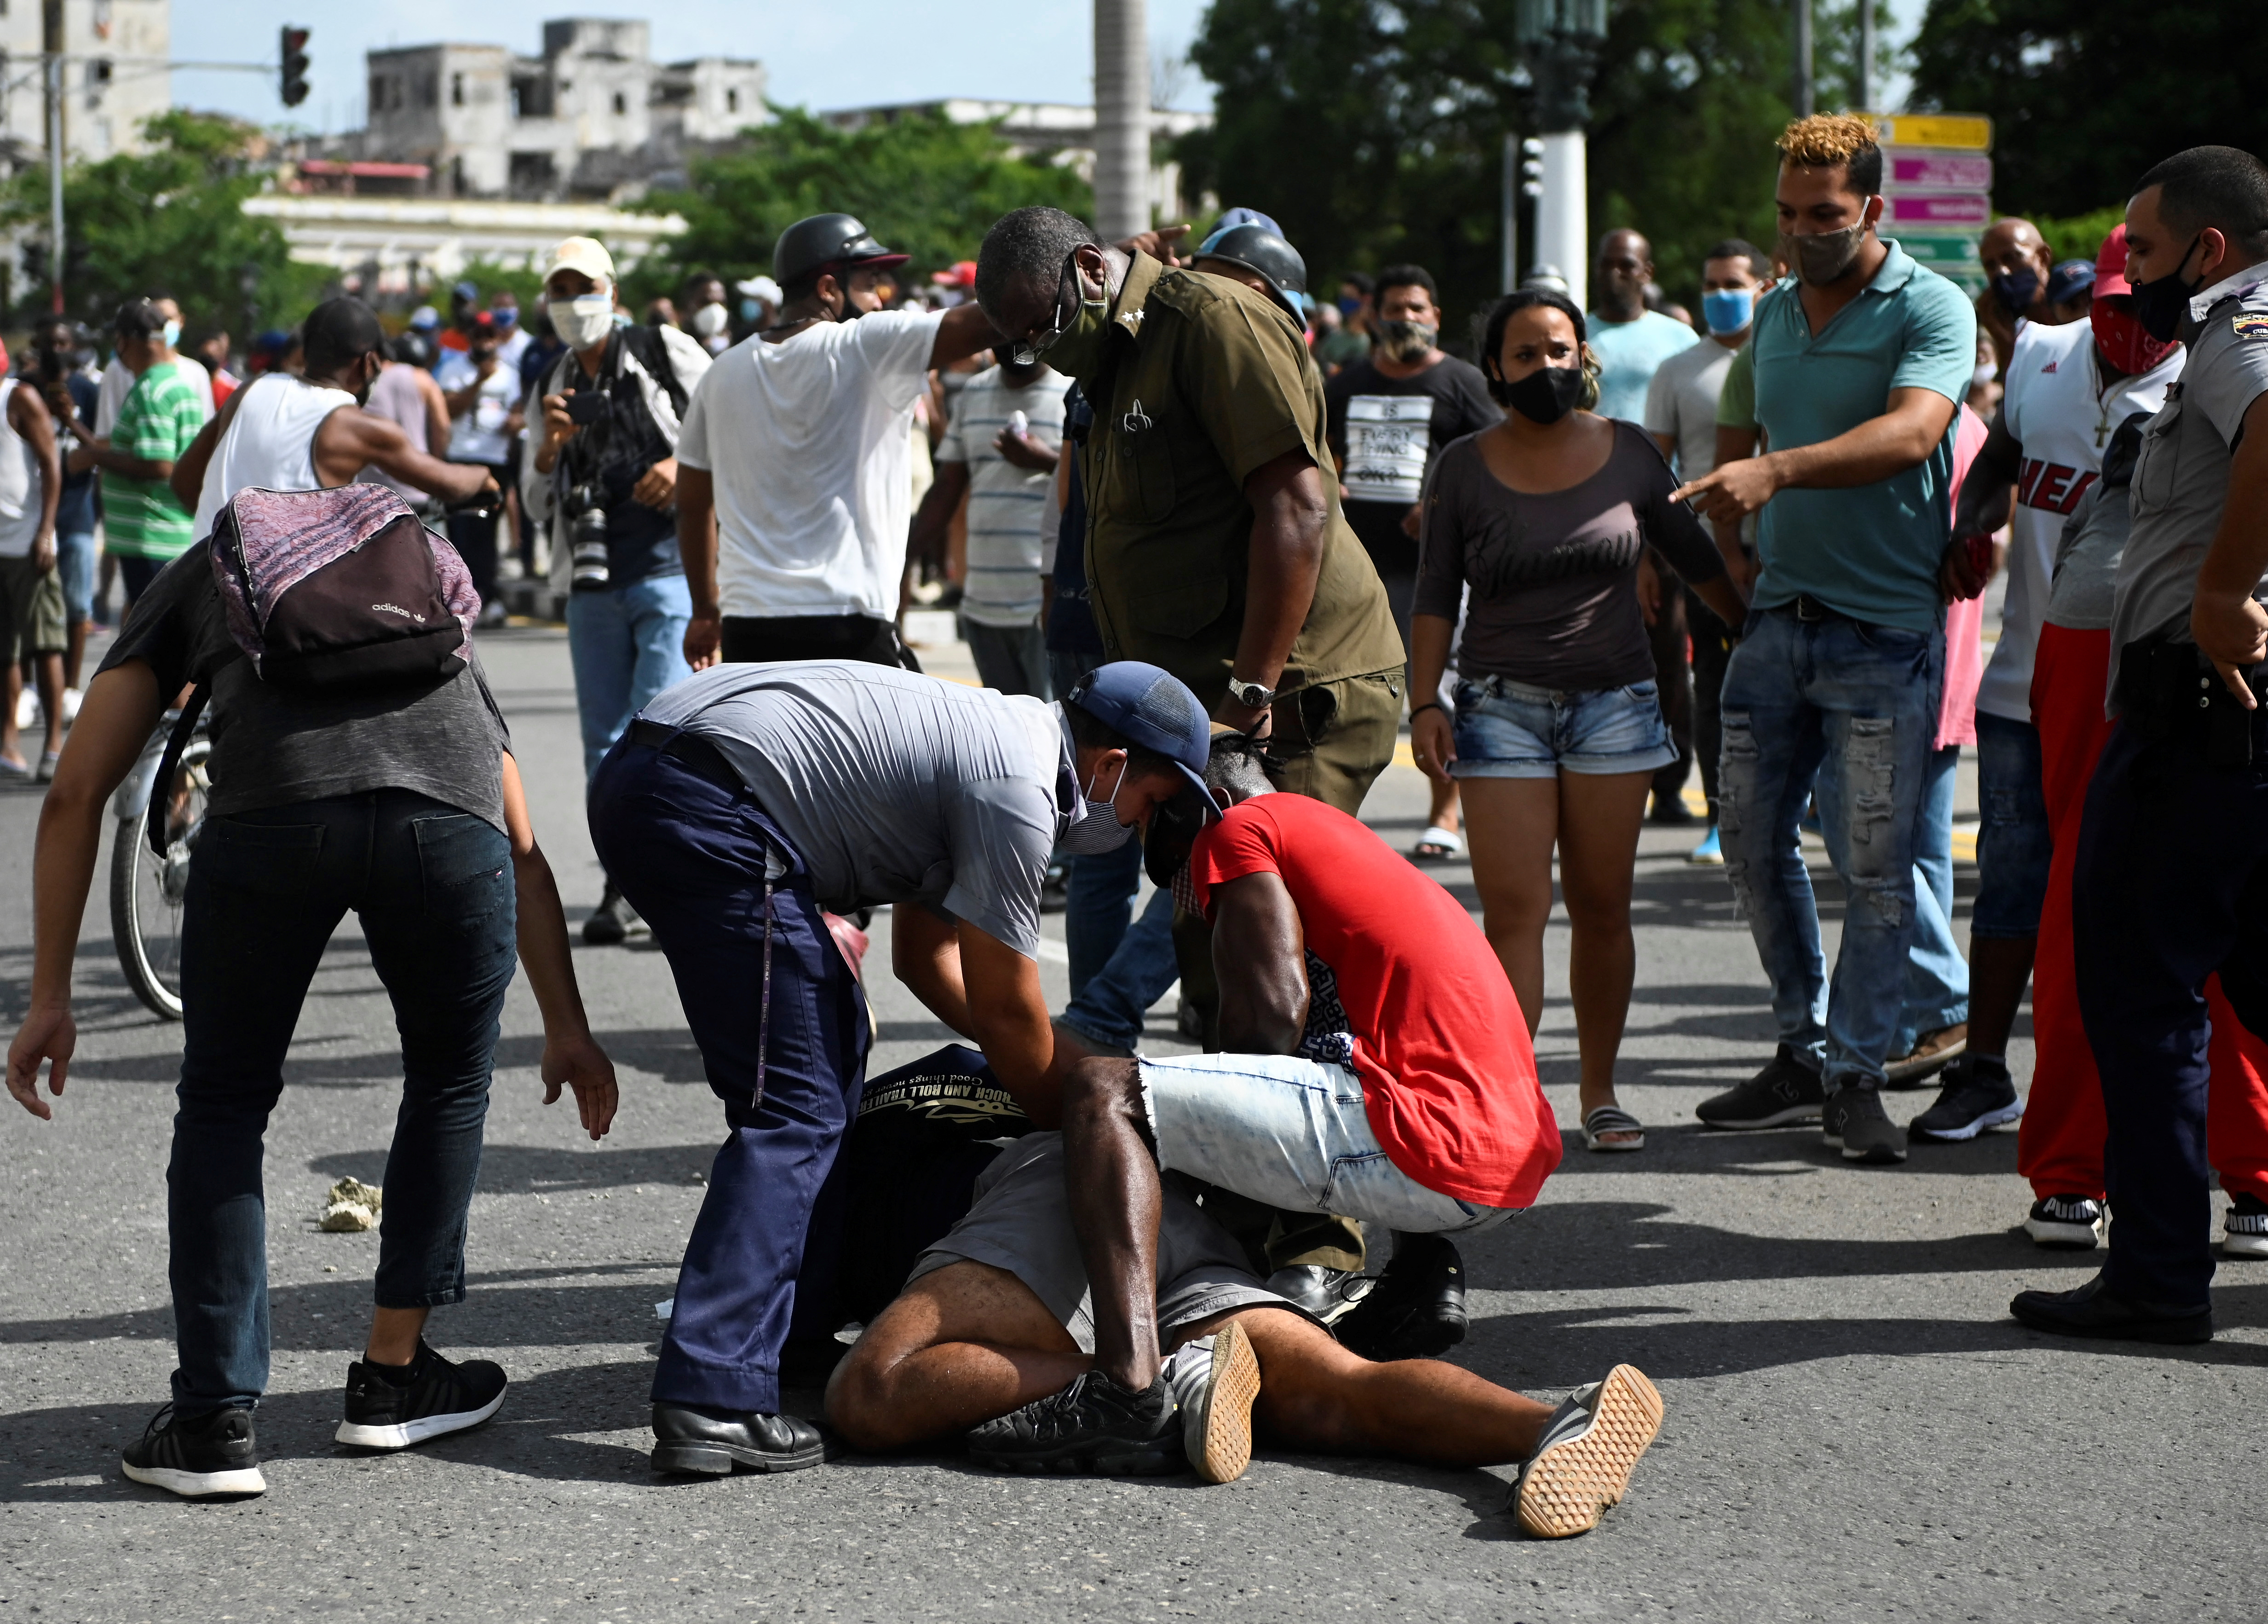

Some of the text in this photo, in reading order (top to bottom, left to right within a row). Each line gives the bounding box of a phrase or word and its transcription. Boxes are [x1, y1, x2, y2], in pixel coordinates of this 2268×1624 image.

[372, 603, 410, 618] adidas
[875, 1079, 906, 1094] never
[909, 1074, 945, 1084] things
[950, 1074, 983, 1086] Good
[859, 1084, 1012, 1113] ROCK AND ROLL TRAILER
[2043, 1196, 2099, 1220] PUMA
